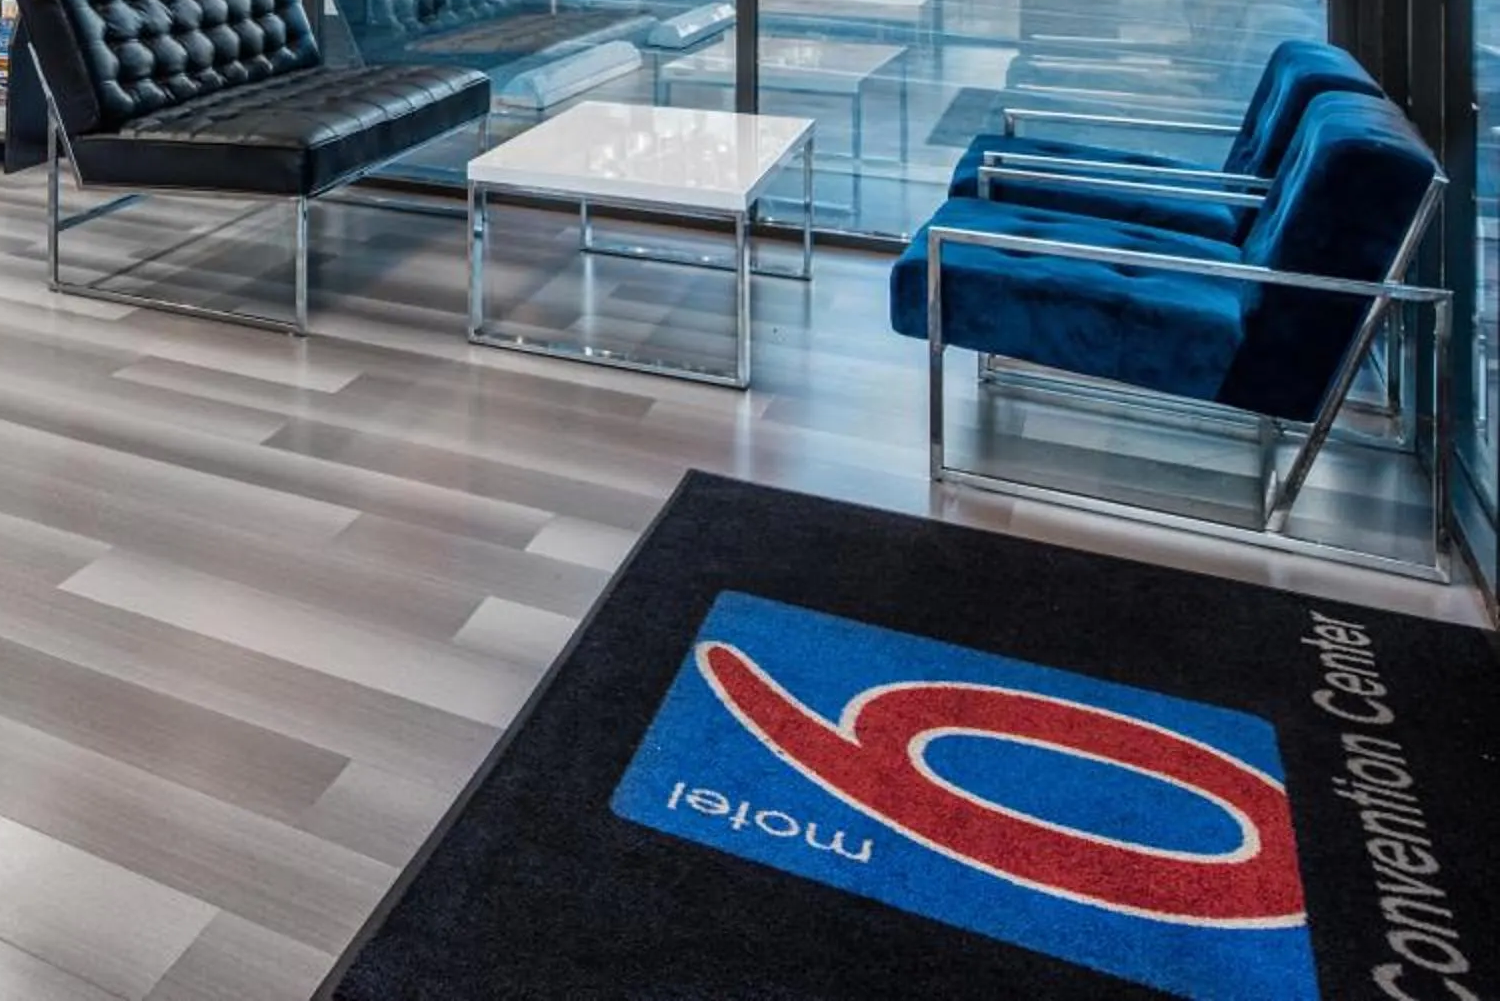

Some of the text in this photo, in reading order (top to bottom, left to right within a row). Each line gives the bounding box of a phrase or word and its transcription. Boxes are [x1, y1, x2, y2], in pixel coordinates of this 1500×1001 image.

[1301, 609, 1395, 725] Center
[667, 781, 873, 864] motel
[694, 641, 1307, 929] 6
